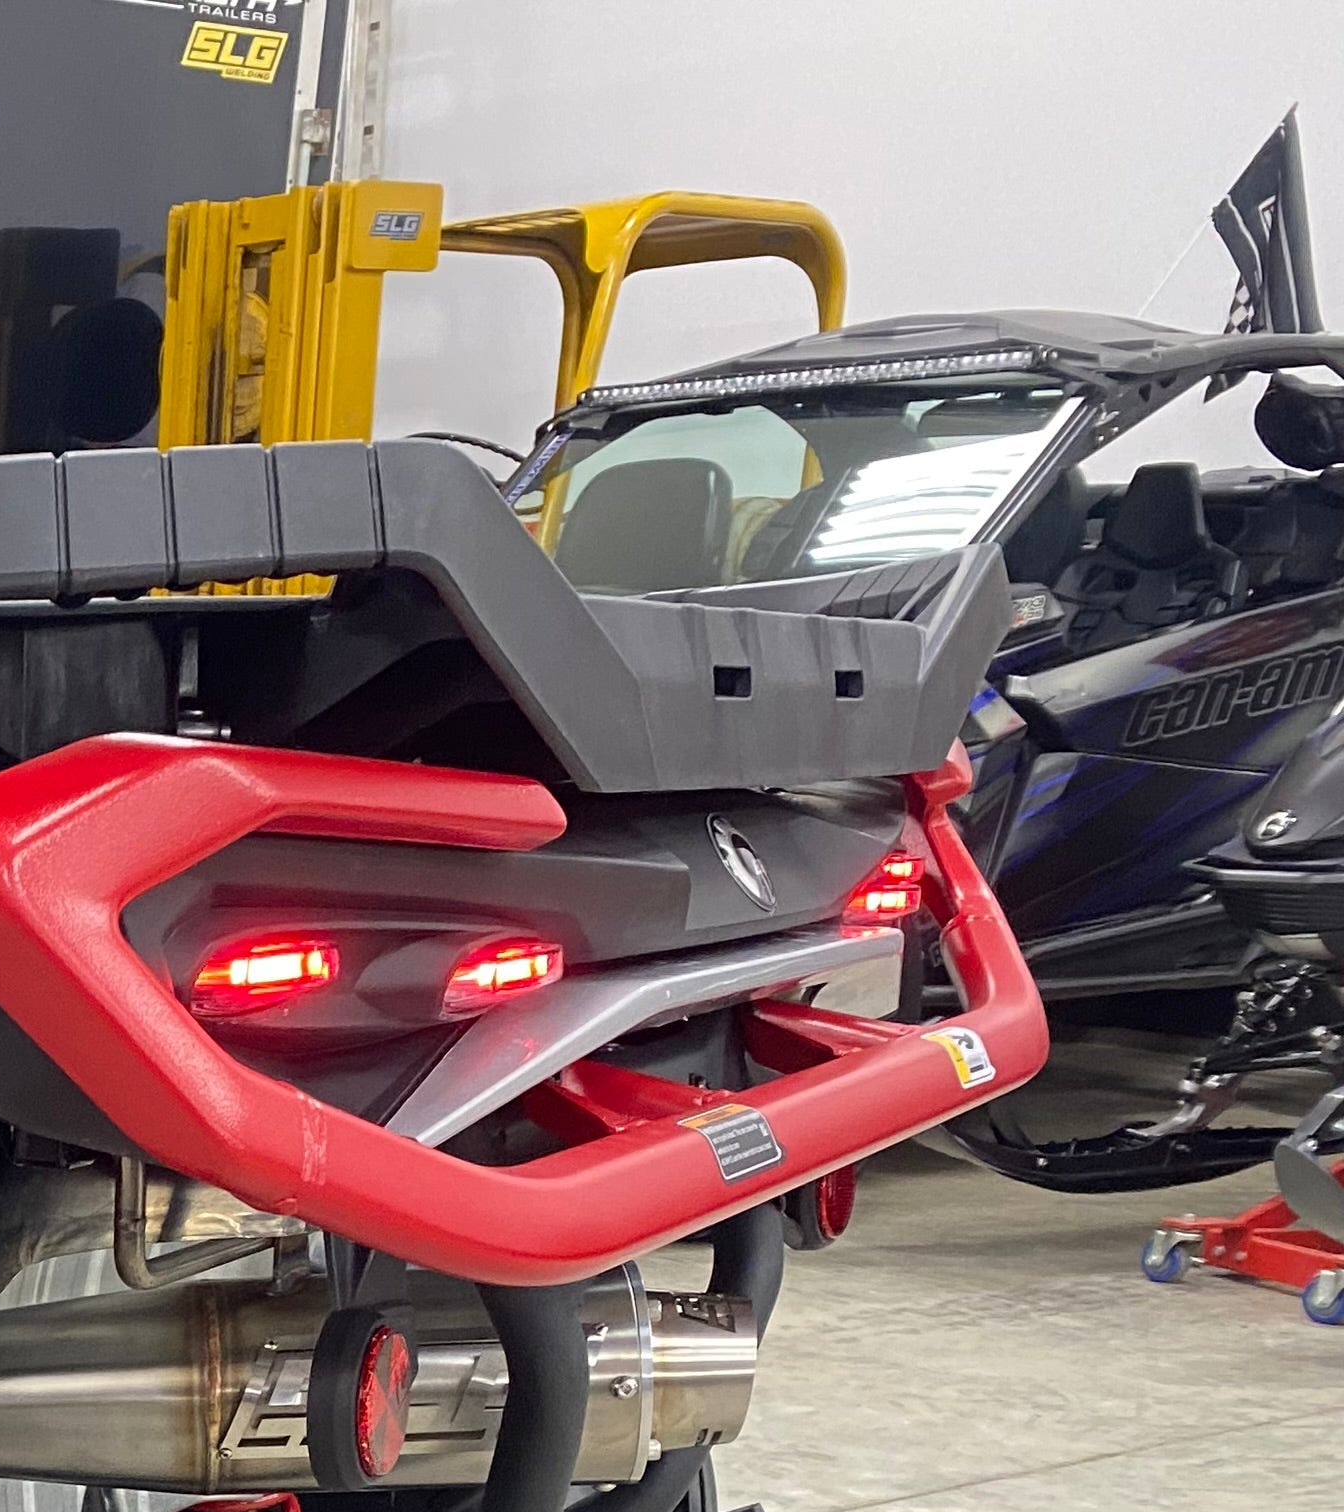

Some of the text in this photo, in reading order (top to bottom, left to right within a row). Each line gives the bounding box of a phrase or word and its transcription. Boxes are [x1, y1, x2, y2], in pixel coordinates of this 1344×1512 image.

[188, 2, 277, 24] TRAILERS
[189, 28, 281, 70] SLG
[225, 67, 271, 80] WELDING
[375, 215, 419, 232] SLG
[1123, 646, 1344, 748] can-am
